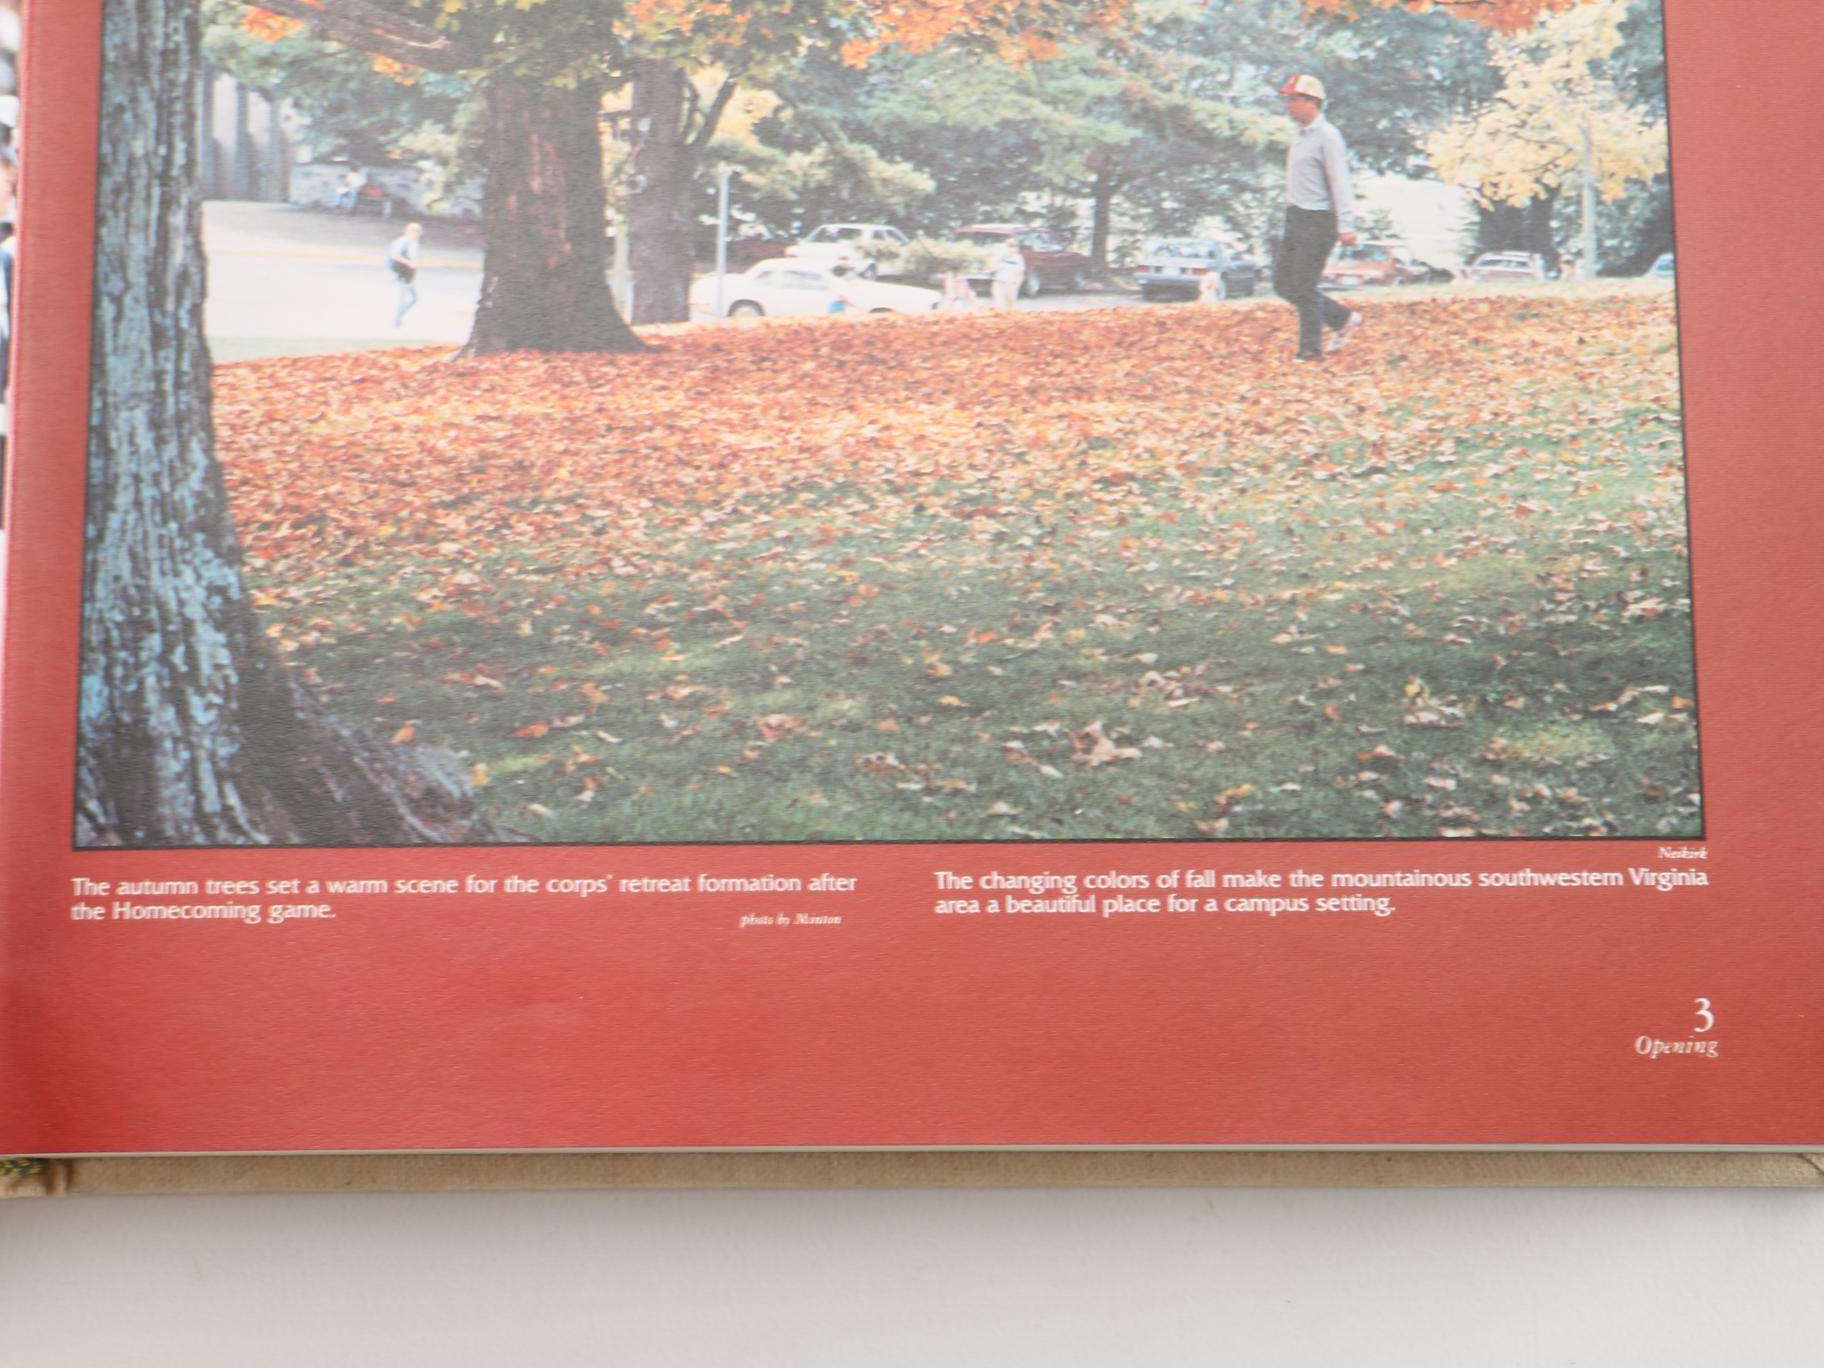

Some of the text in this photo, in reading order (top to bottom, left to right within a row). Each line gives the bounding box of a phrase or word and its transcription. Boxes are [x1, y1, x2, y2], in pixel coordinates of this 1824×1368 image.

[72, 873, 857, 897] The autumn trees set a warm scene for the corps' retreat formation after
[934, 868, 1709, 894] The changing colors of fall make the mountainous southwestern Virginia
[71, 901, 336, 924] the Homecoming game.
[935, 894, 1395, 917] area a beautiful place for a campus setting.
[1694, 998, 1714, 1032] 3
[1635, 1036, 1718, 1059] Opening
